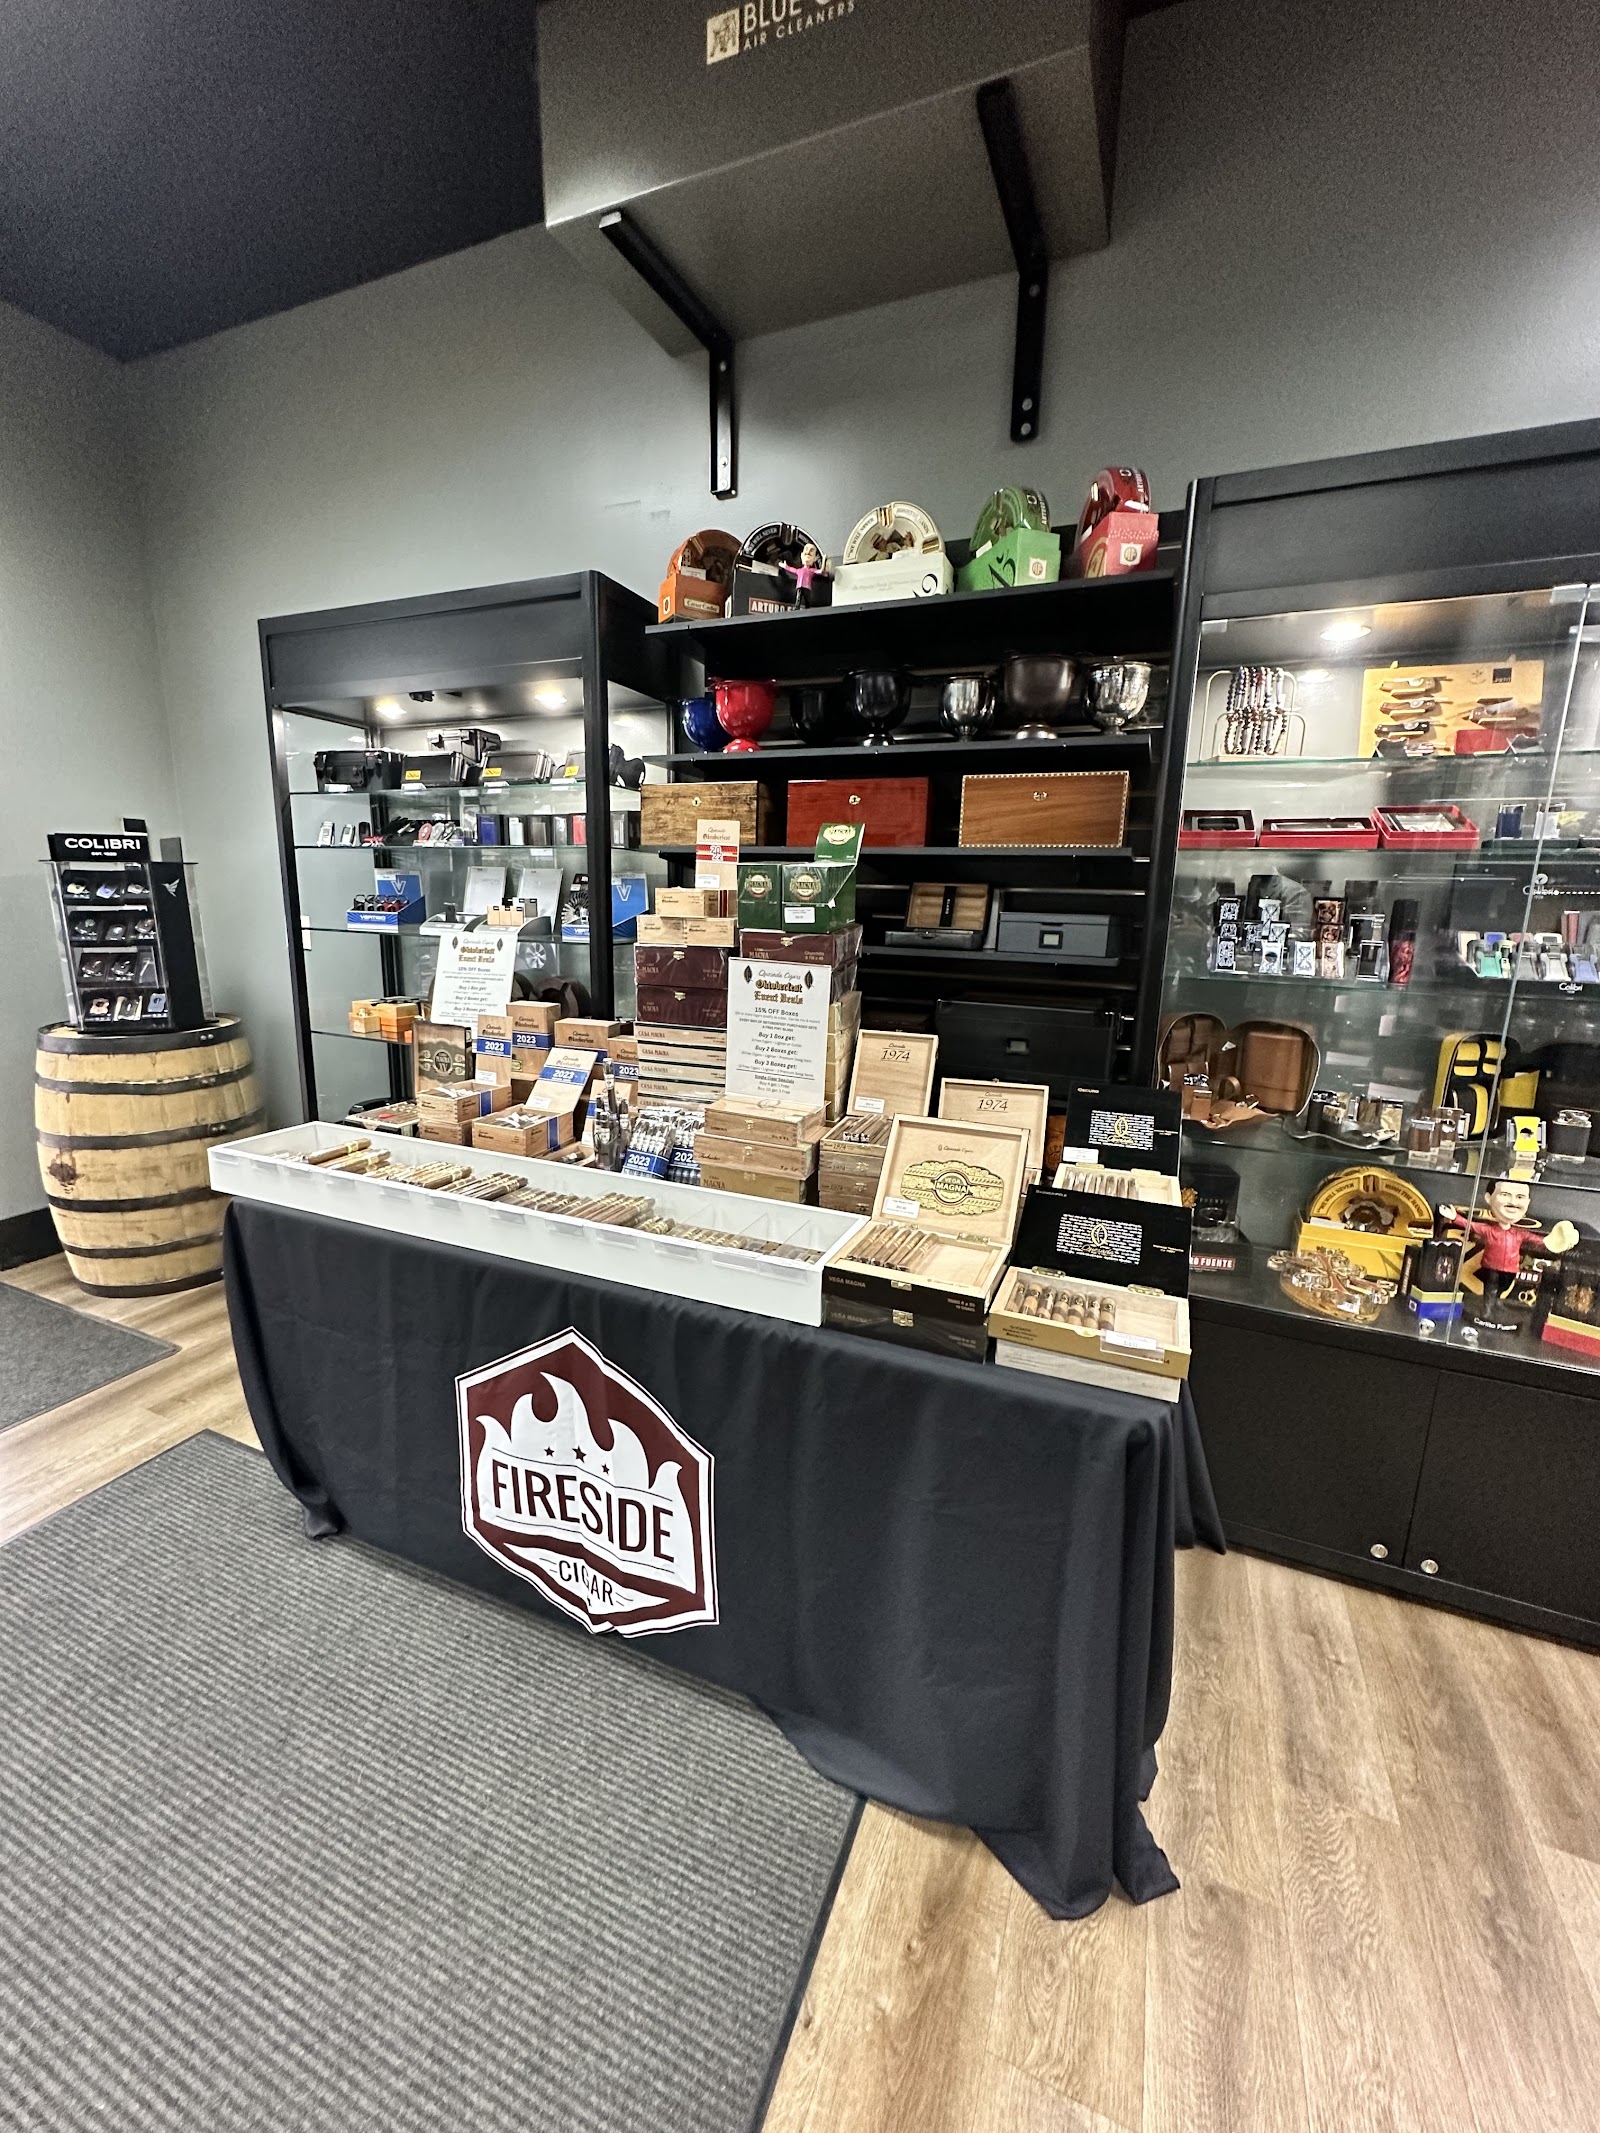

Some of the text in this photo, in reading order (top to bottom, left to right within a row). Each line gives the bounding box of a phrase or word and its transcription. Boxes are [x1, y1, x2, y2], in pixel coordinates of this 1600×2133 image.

[743, 3, 855, 50] AIR CLEANERS
[65, 838, 141, 850] COLIBRI
[1559, 982, 1583, 991] Colibri
[517, 1035, 536, 1044] 2023
[485, 1041, 504, 1051] 2023
[881, 1050, 910, 1061] 1974
[553, 1070, 574, 1078] 2023
[619, 1066, 638, 1075] 2023
[977, 1099, 1008, 1111] 1974
[628, 1155, 651, 1166] 2023
[675, 1152, 693, 1161] 202
[936, 1182, 968, 1193] MAGNA
[1201, 1258, 1233, 1268] FUENTE
[828, 1276, 866, 1288] VEGA MAGNA
[491, 1458, 675, 1563] FIRESIDE
[559, 1560, 613, 1606] CIGAR
